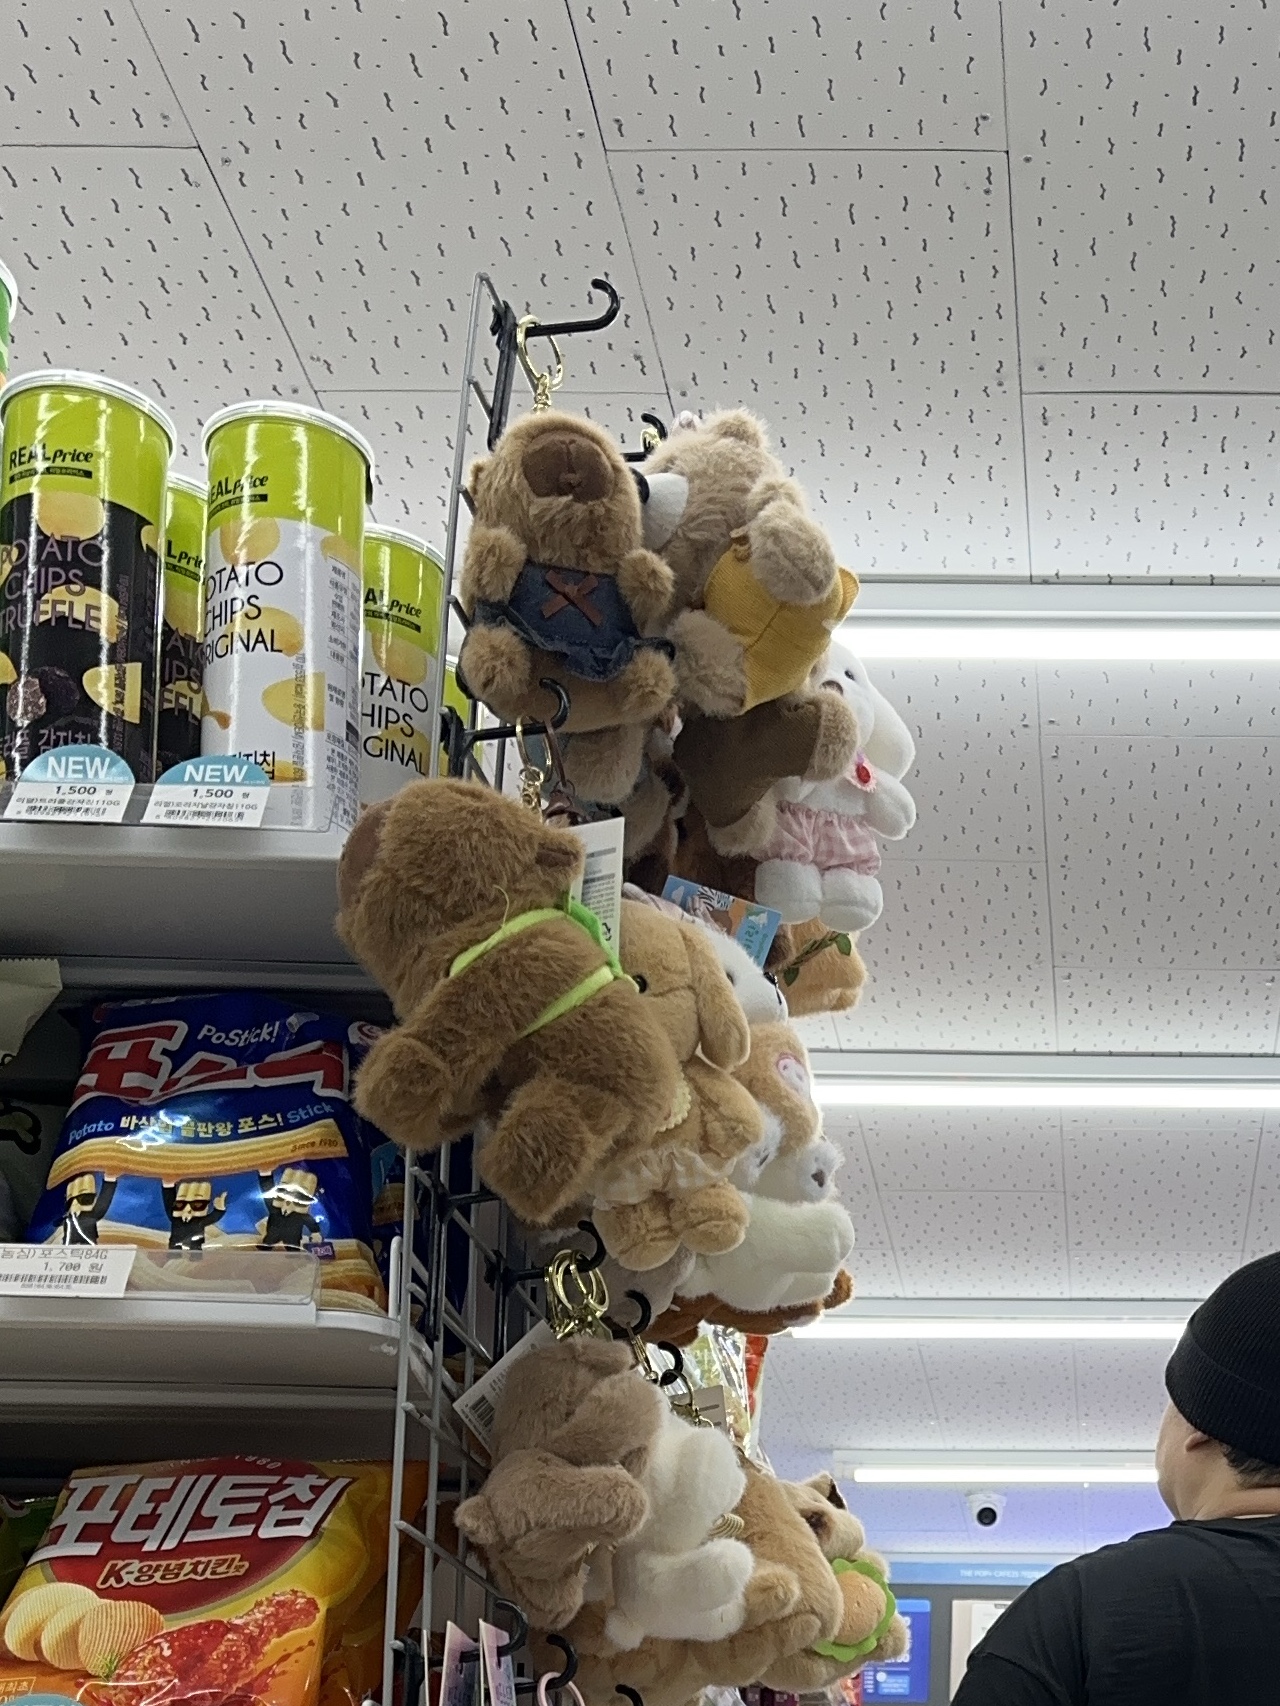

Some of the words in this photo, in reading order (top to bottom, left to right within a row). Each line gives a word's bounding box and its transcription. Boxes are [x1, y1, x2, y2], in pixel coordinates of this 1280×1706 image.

[5, 567, 87, 601] CHIPS
[361, 699, 415, 738] HIPS
[47, 756, 111, 779] NEW
[184, 764, 249, 783] NEW
[55, 785, 97, 796] 1,500
[192, 788, 234, 799] 1,500
[68, 1120, 116, 1146] Potato
[236, 1113, 285, 1135] 포스!
[286, 1100, 335, 1125] Stick
[28, 1474, 355, 1564] 포테토칩
